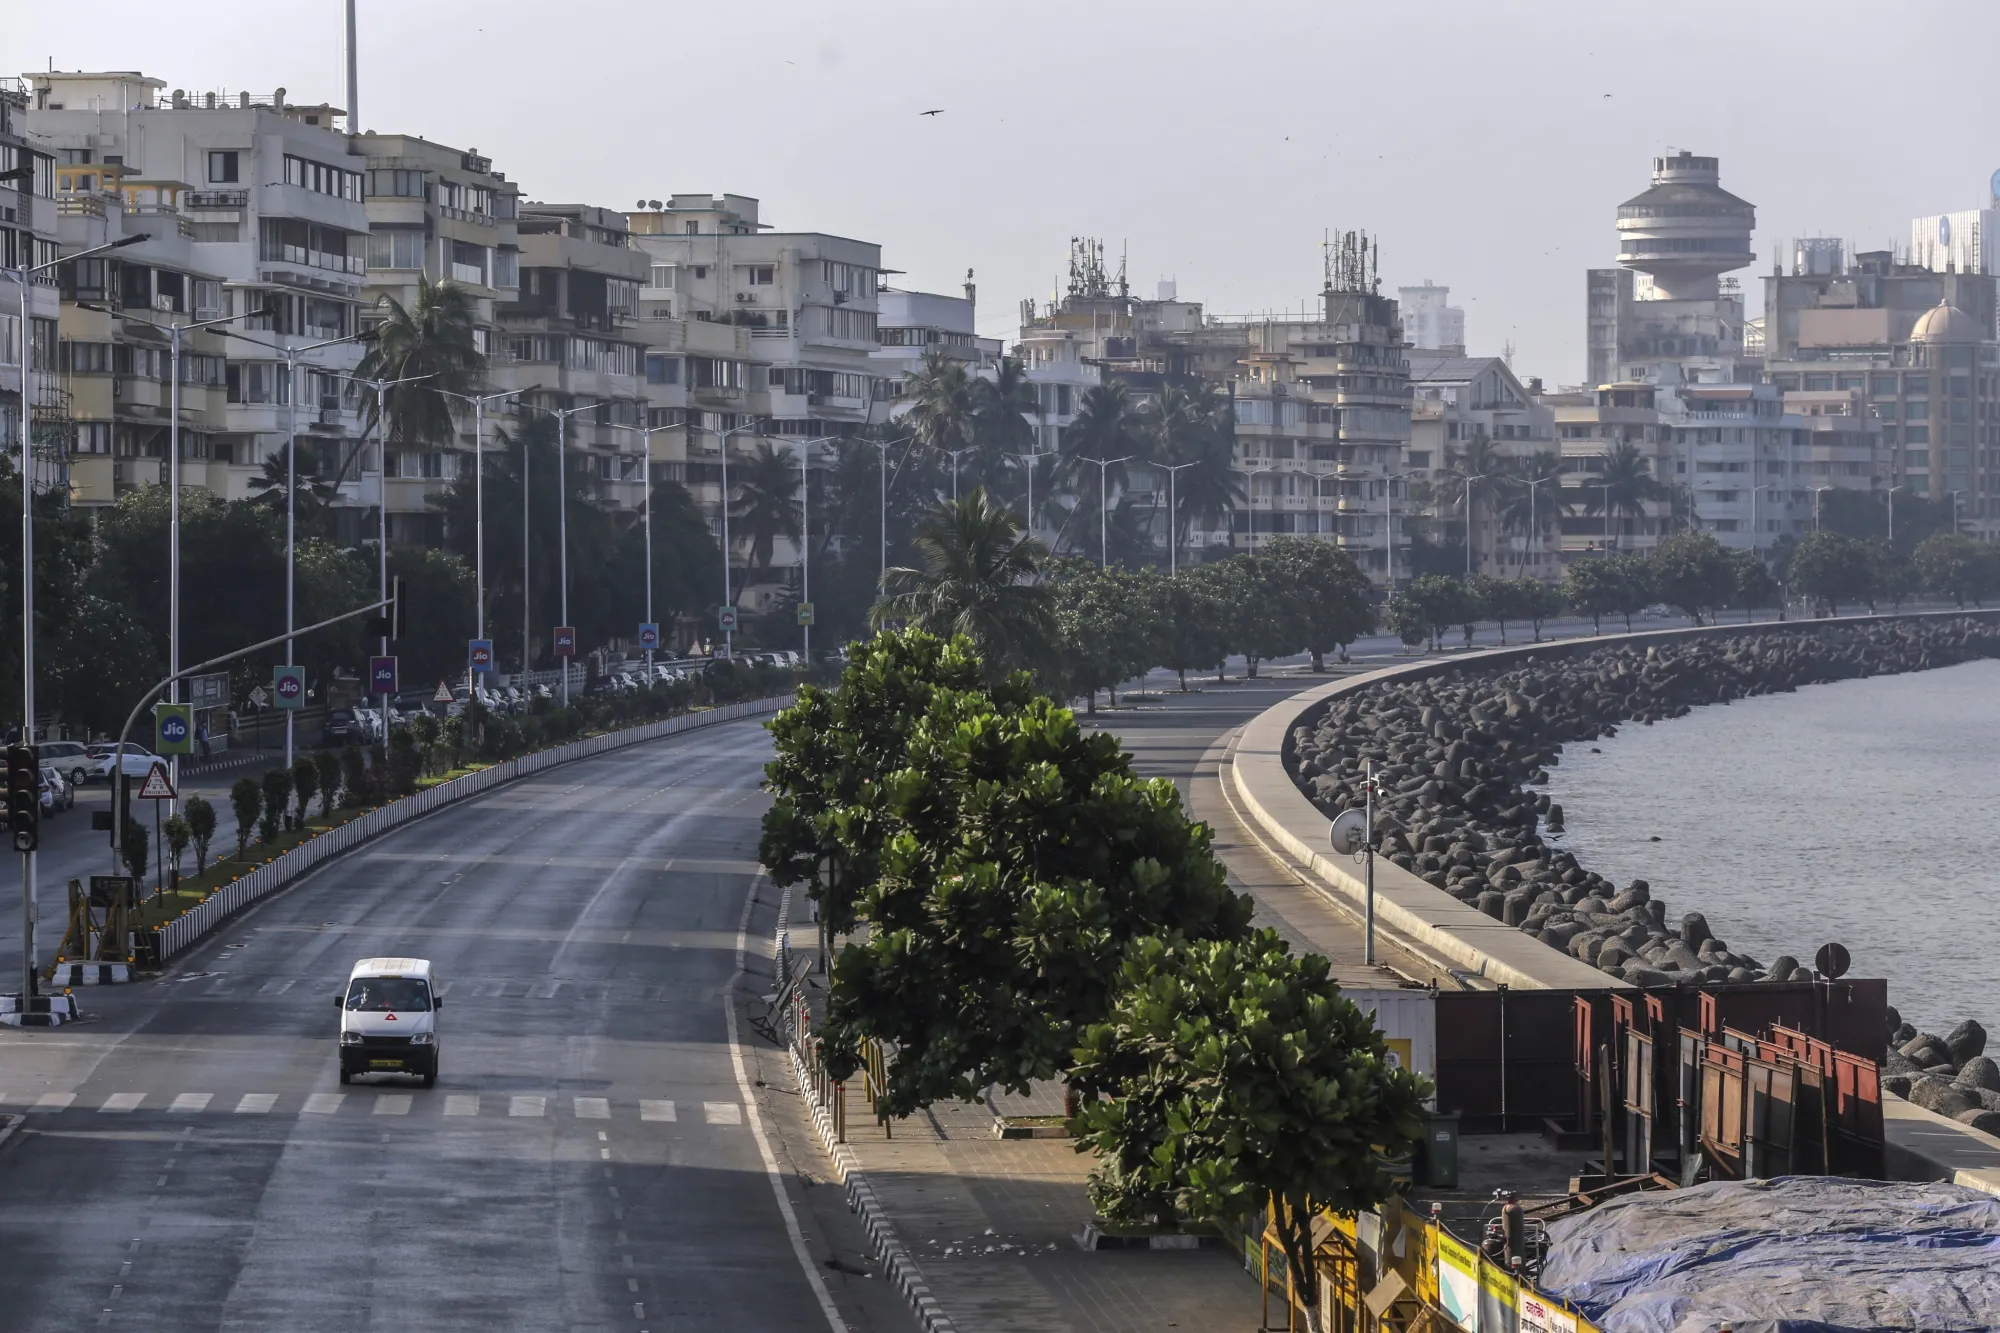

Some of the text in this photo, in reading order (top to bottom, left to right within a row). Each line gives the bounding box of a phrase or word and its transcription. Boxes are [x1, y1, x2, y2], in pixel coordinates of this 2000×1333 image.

[643, 632, 654, 640] Jio
[559, 637, 571, 645] Jio
[474, 652, 487, 660] Jio
[376, 670, 391, 679] Jio
[280, 682, 298, 692] Jio
[164, 723, 185, 735] Jio
